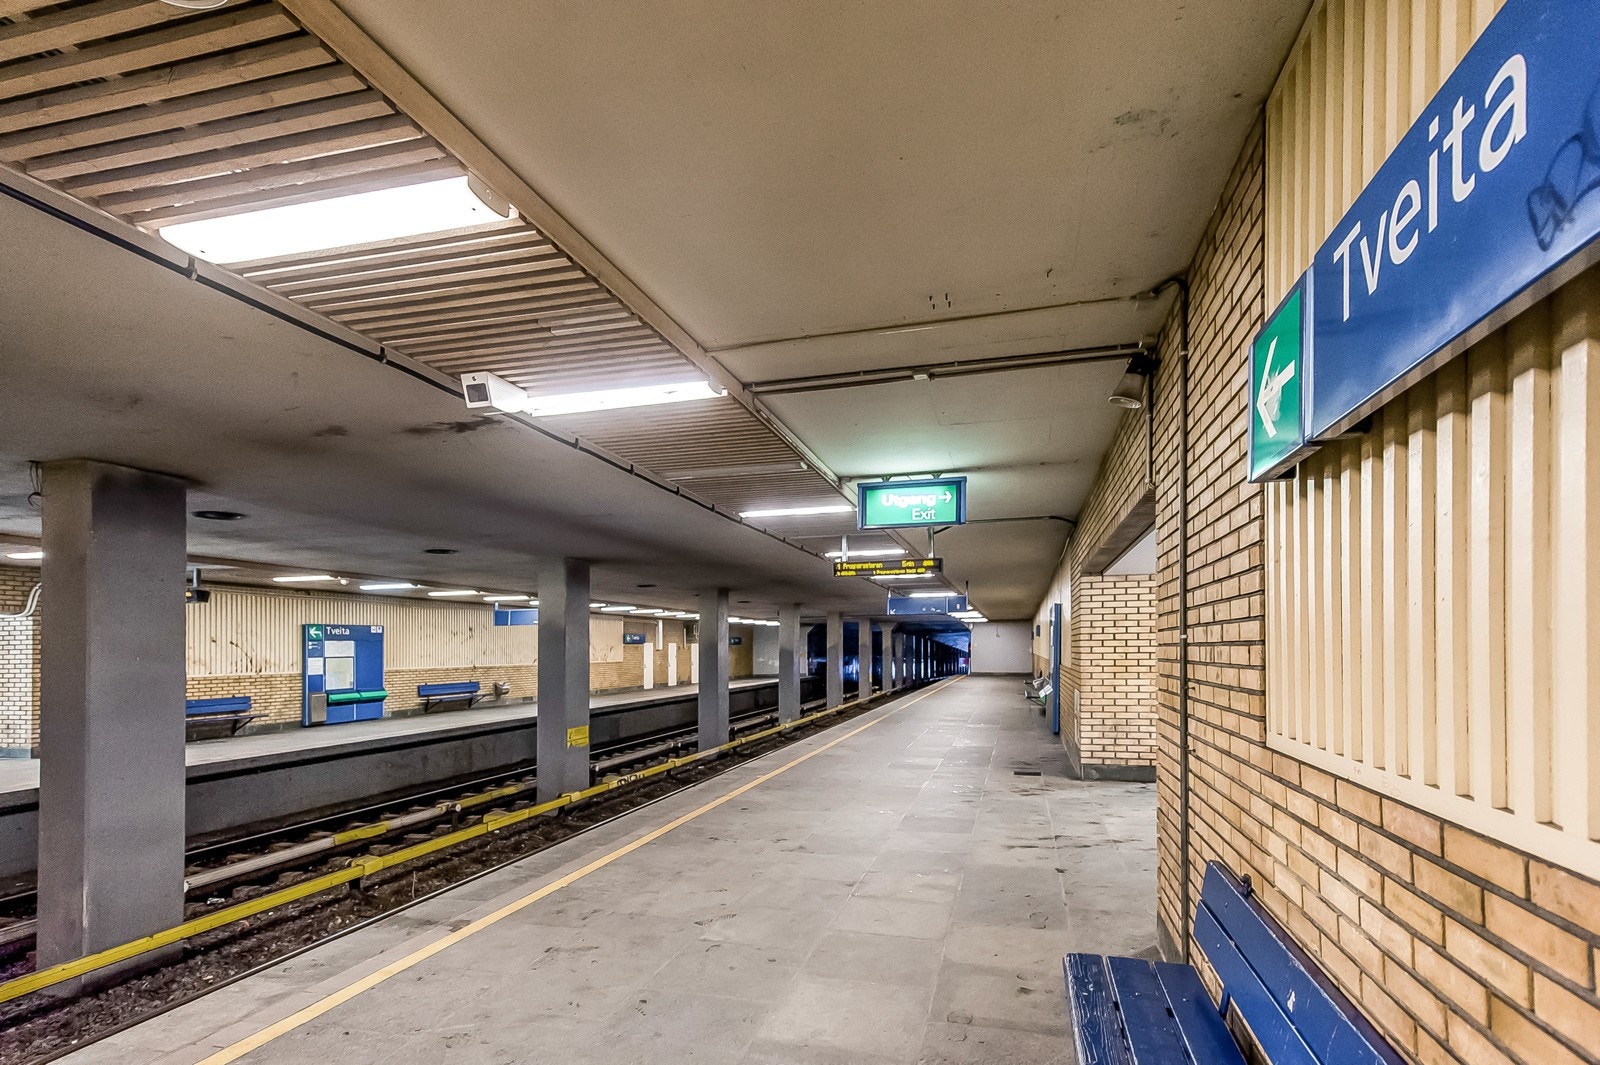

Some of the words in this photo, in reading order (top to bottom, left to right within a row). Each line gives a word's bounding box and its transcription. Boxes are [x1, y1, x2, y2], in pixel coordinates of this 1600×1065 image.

[1333, 53, 1527, 323] Tveita
[912, 507, 936, 520] Exit
[326, 626, 350, 635] Tveita
